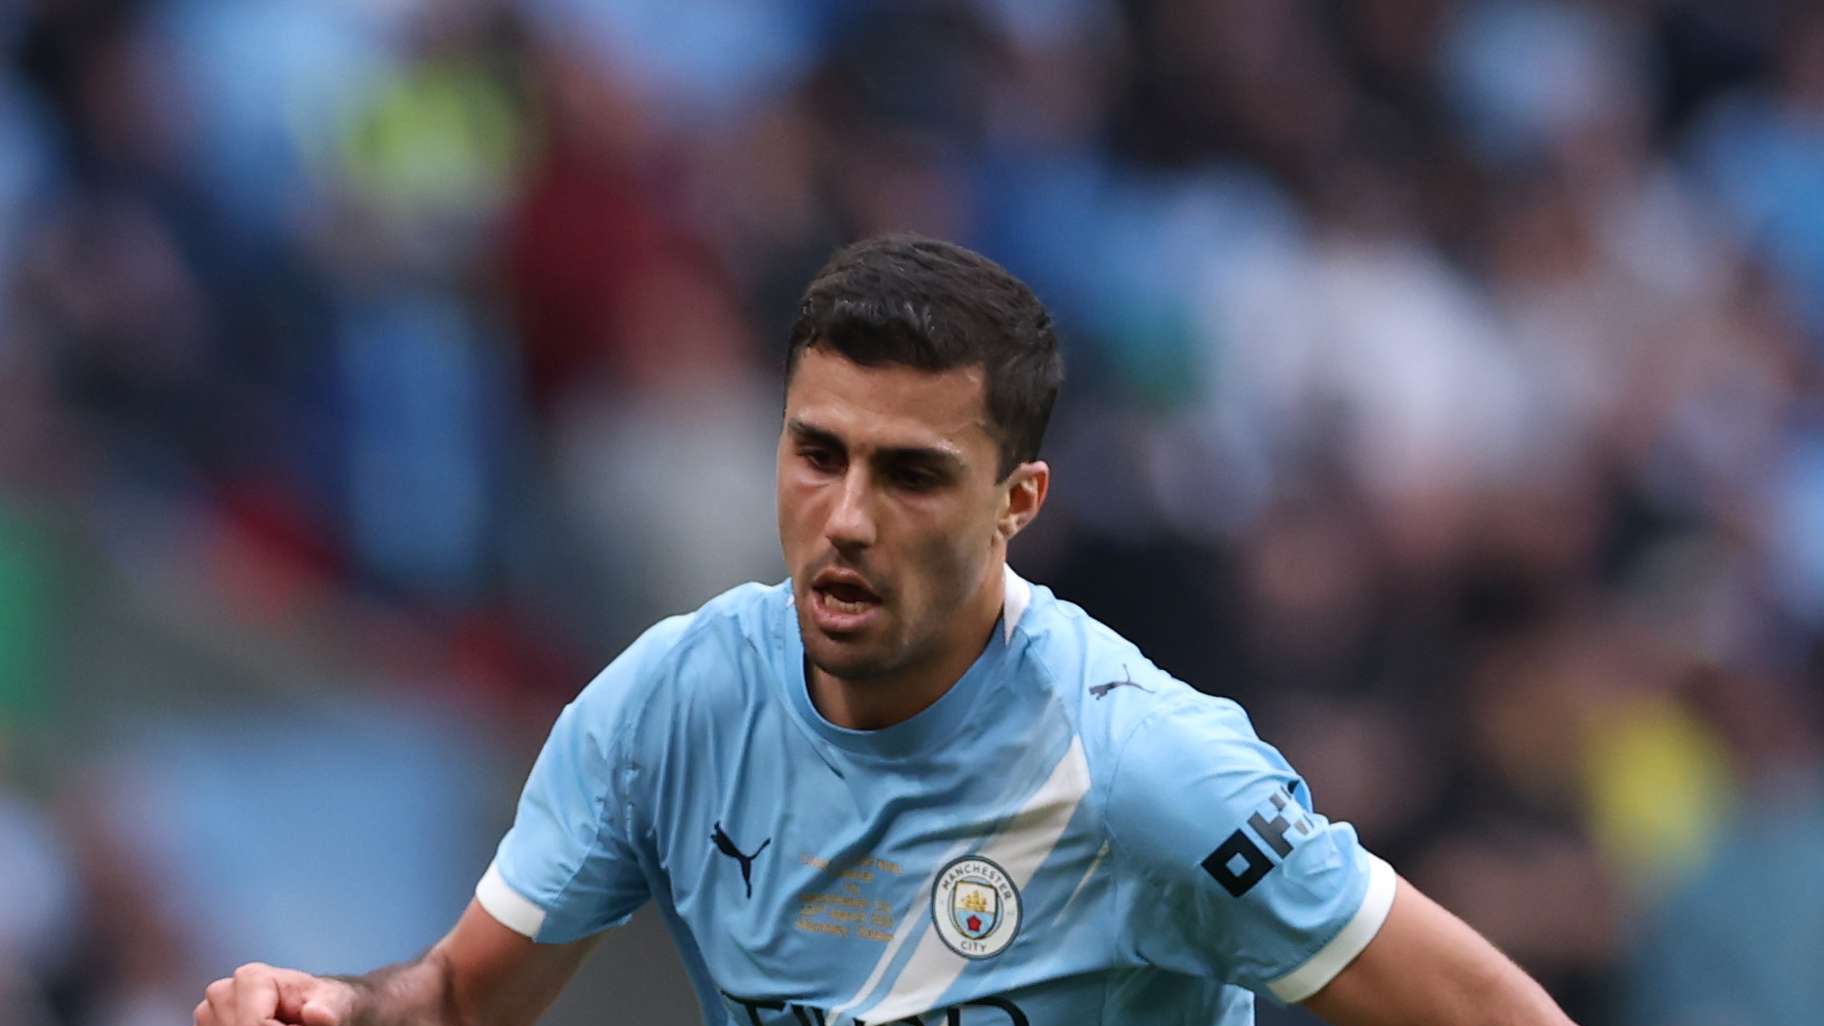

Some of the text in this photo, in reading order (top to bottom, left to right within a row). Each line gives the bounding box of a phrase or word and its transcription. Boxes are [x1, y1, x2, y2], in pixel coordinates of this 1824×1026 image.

[1200, 780, 1314, 898] OK
[942, 864, 1013, 900] MANCHESTER
[960, 941, 989, 952] CITY
